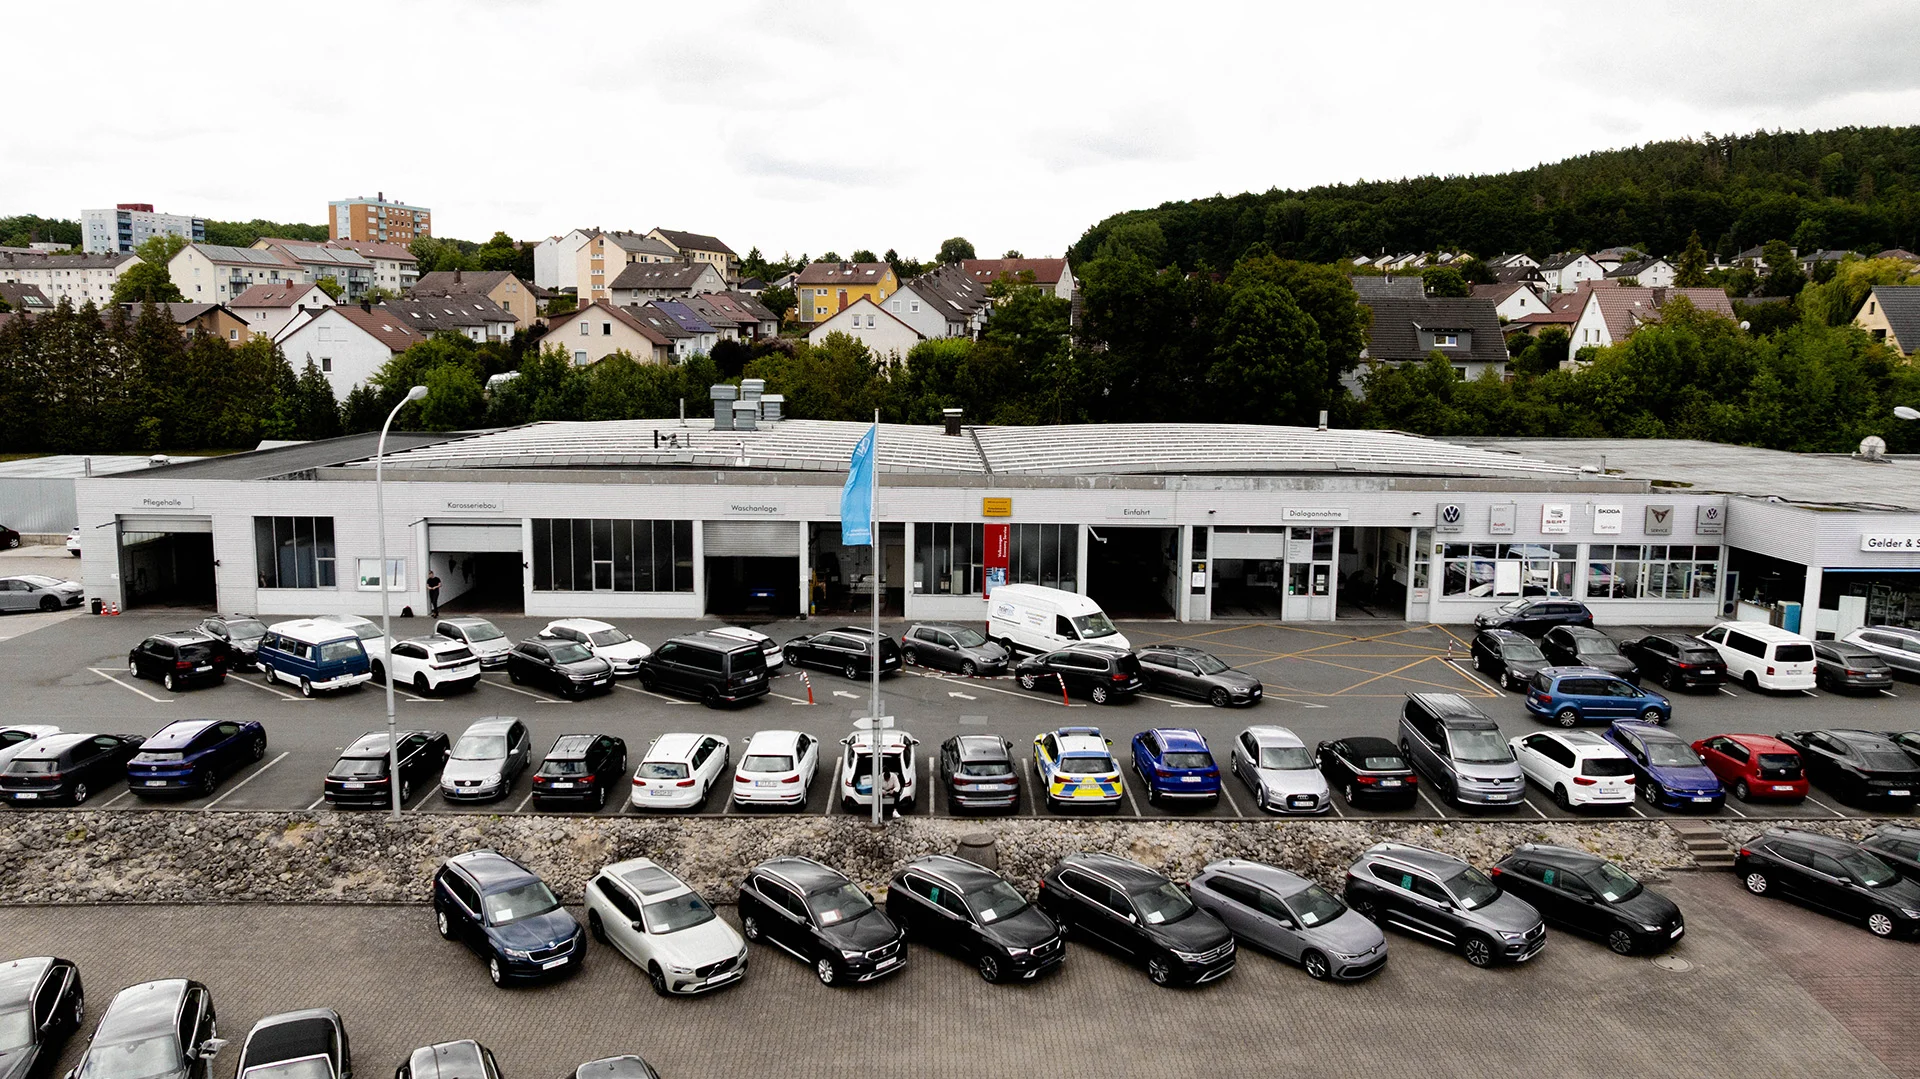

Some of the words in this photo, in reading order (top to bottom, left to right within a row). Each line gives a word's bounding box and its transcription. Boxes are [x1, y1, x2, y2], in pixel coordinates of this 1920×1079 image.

[143, 498, 181, 507] Pflegehalle
[447, 501, 497, 509] Karosseriebau
[731, 504, 777, 513] Waschanlage
[1123, 508, 1150, 516] Einfahrt
[1289, 509, 1342, 518] Dialogannahme
[1868, 538, 1902, 548] Gelder
[1905, 538, 1912, 548] &
